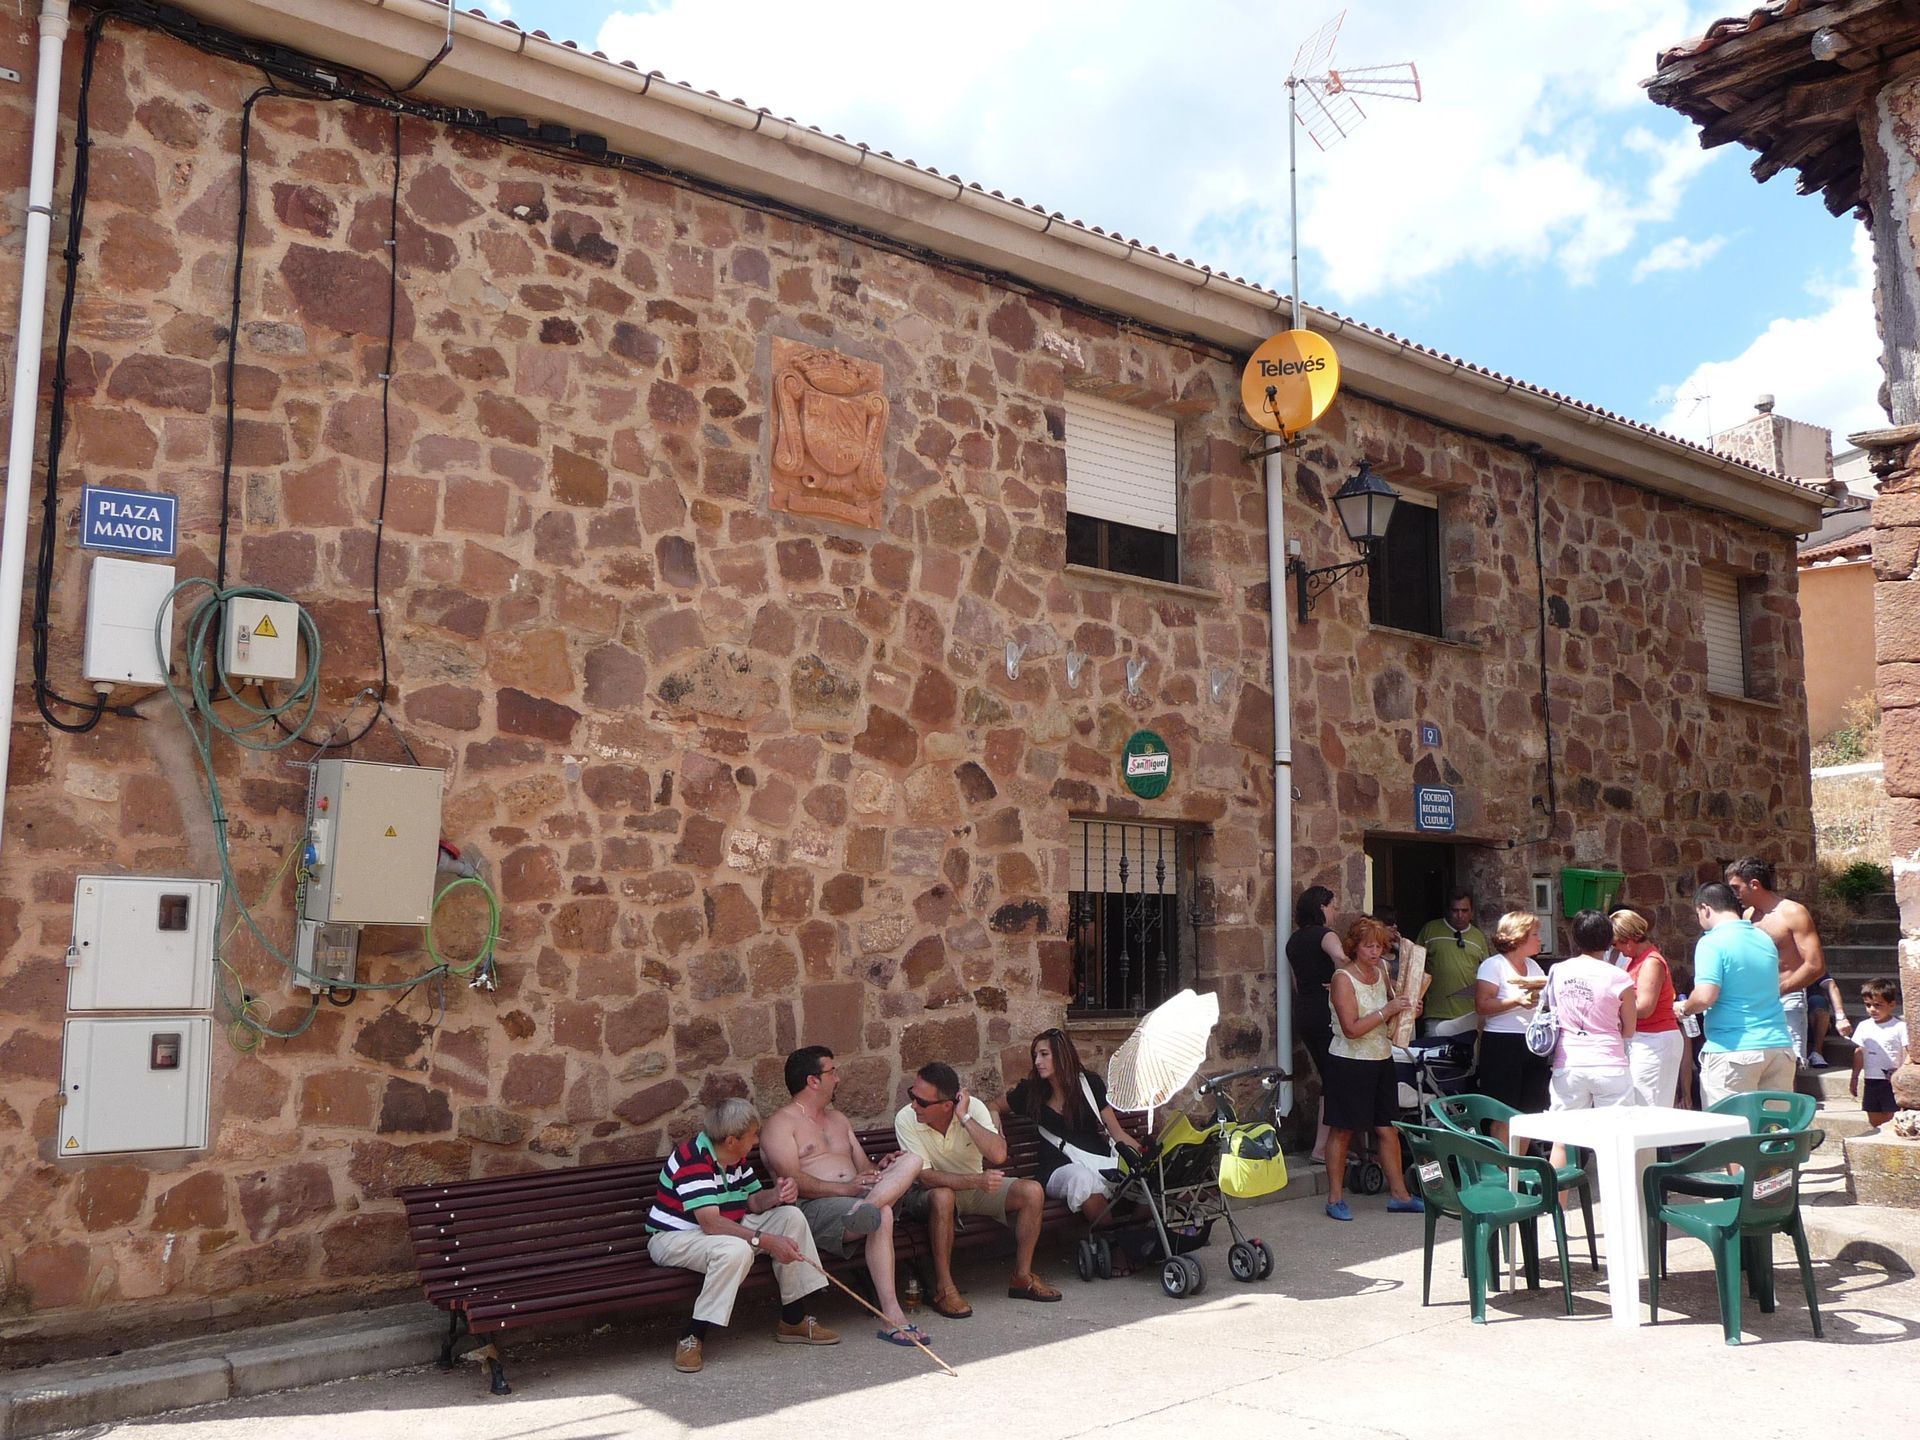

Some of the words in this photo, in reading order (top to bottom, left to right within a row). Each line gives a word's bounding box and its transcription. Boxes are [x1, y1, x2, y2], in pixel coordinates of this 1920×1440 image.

[1257, 355, 1326, 377] Televés
[99, 501, 161, 522] PLAZA
[94, 521, 164, 542] MAYOR
[1427, 730, 1434, 743] 9
[1423, 792, 1449, 803] SOCIEDAD
[1422, 804, 1451, 814] RECREATIVA
[1424, 815, 1450, 825] CULTURAL
